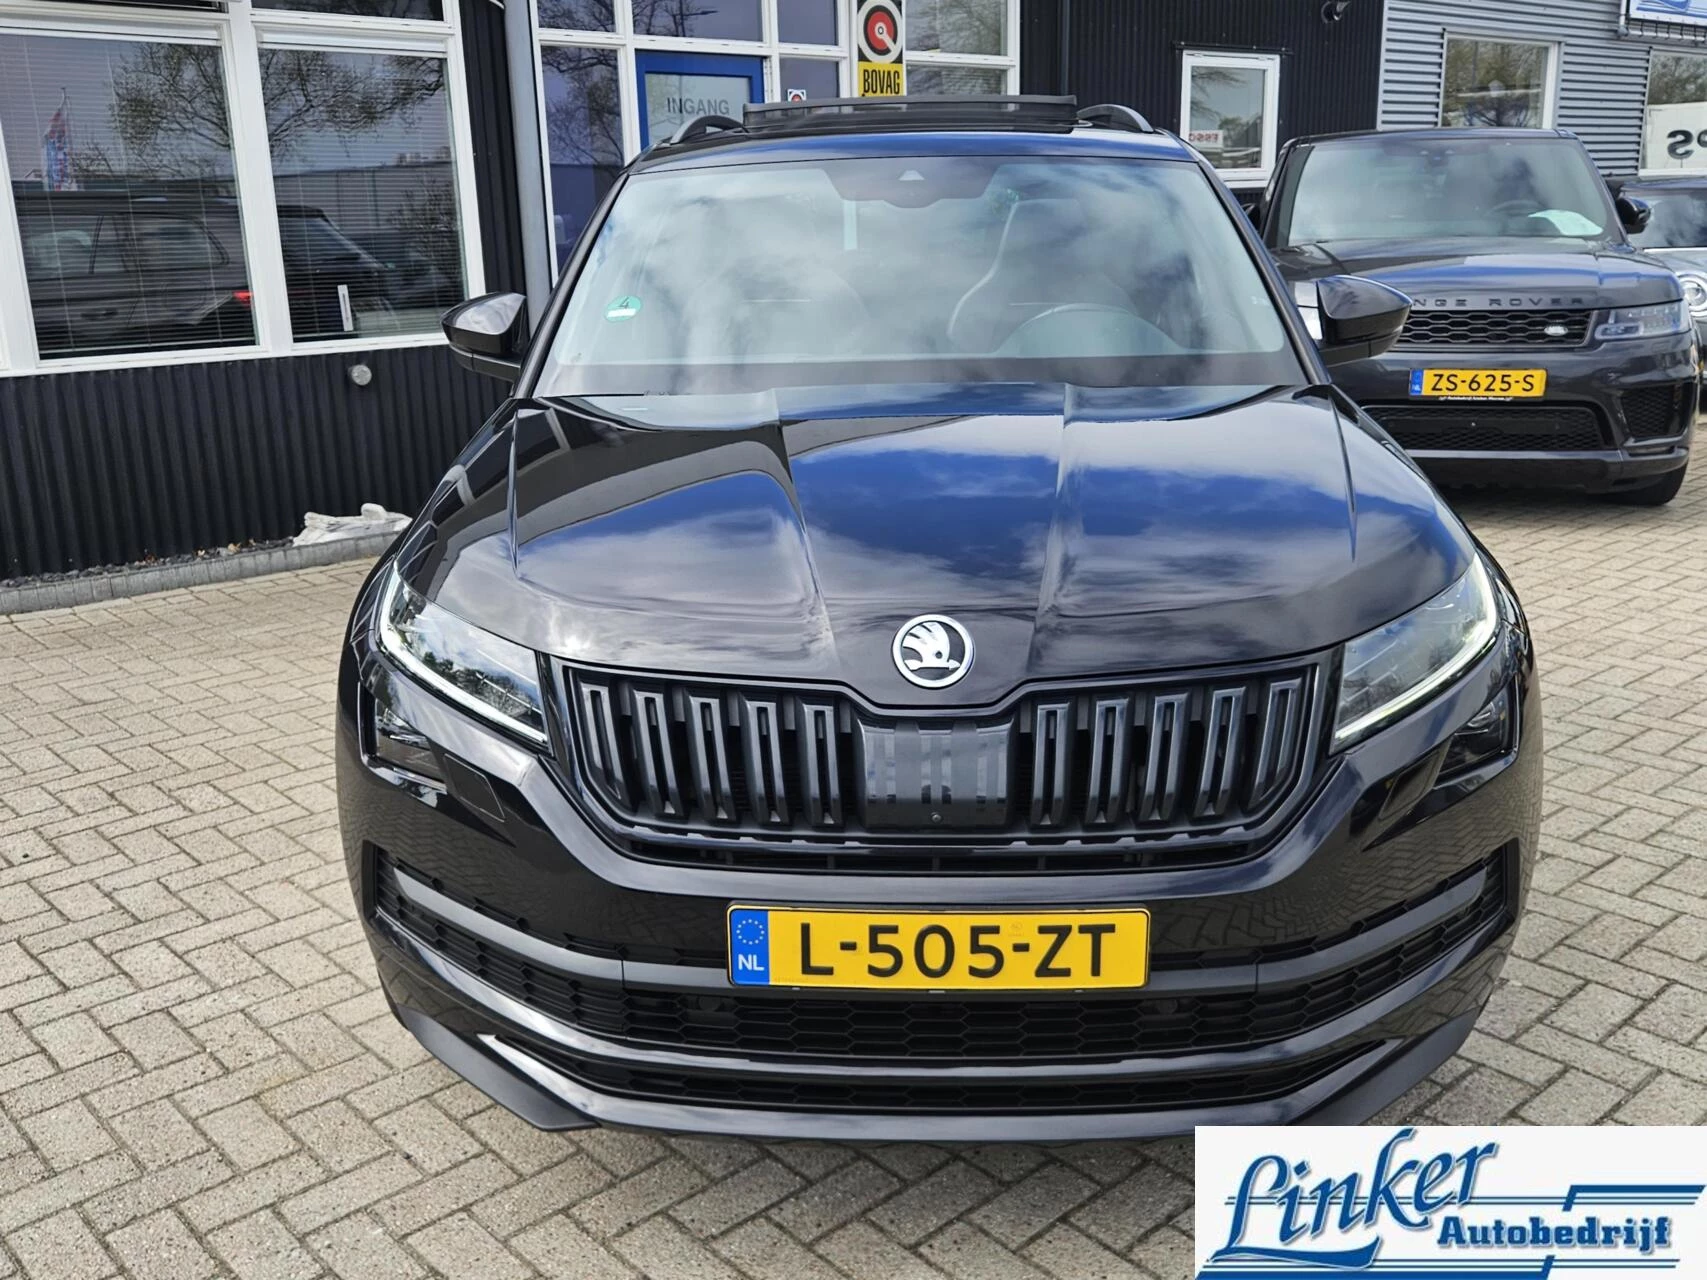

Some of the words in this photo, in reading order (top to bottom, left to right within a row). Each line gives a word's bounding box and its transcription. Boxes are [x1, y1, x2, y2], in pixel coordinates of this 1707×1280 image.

[863, 69, 901, 95] BOVAG
[667, 97, 730, 115] INGANG
[1412, 298, 1467, 307] NGE
[1489, 298, 1584, 307] ROVER
[1431, 374, 1535, 392] ZS-625-S
[800, 922, 1117, 979] L-505-ZT
[738, 953, 765, 972] NL
